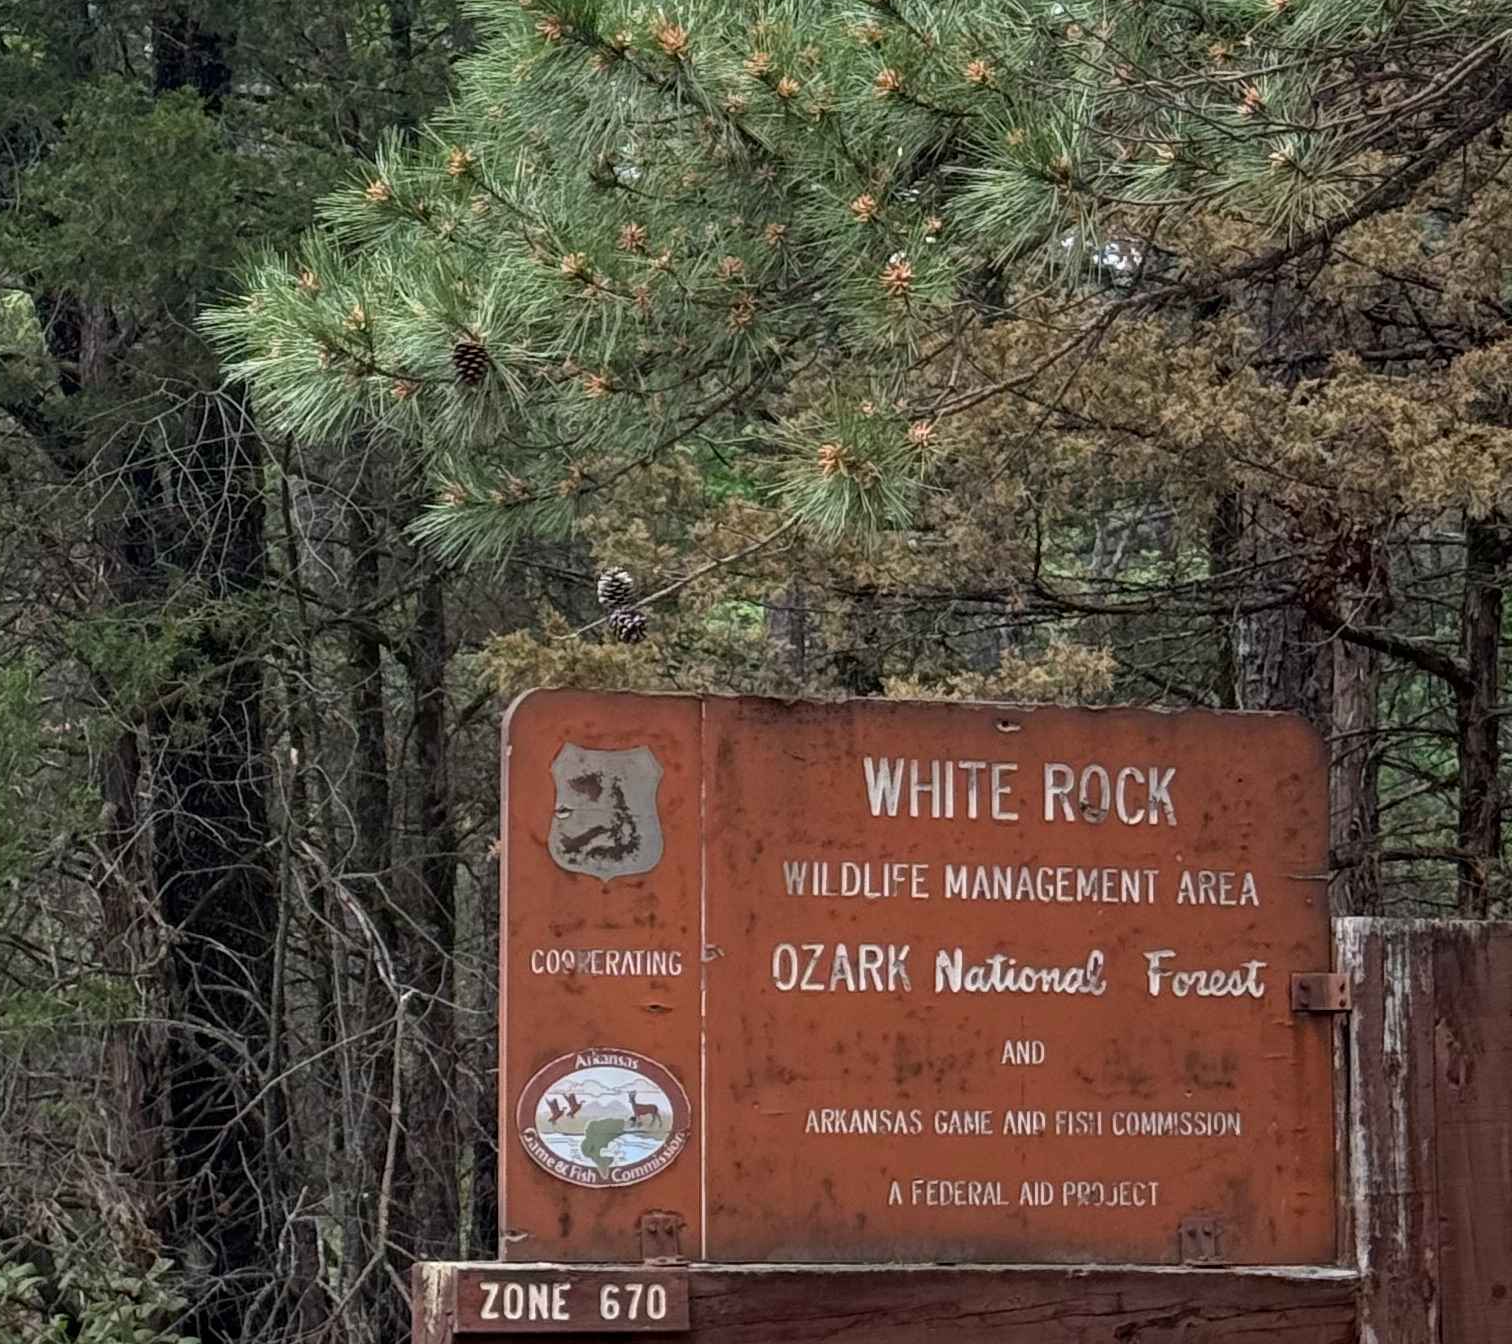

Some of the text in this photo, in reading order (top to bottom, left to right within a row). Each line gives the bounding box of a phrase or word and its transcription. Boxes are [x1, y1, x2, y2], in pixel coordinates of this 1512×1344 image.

[863, 756, 1177, 826] WHITE ROCK
[783, 861, 1259, 907] WILDLIFE MANAGEMENT AREA
[531, 949, 682, 976] COOERATING
[773, 943, 1267, 998] OZARK National Forest
[575, 1052, 639, 1069] Arkansas
[1001, 1040, 1045, 1065] AND
[804, 1109, 1241, 1137] ARKANSAS GAME AND FISH COMMISSION
[523, 1127, 554, 1168] Game
[568, 1167, 597, 1184] Fish
[610, 1131, 686, 1183] Commission
[888, 1180, 1159, 1207] A FEDERAL AID PROJECT
[479, 1282, 667, 1321] ZONE 670
